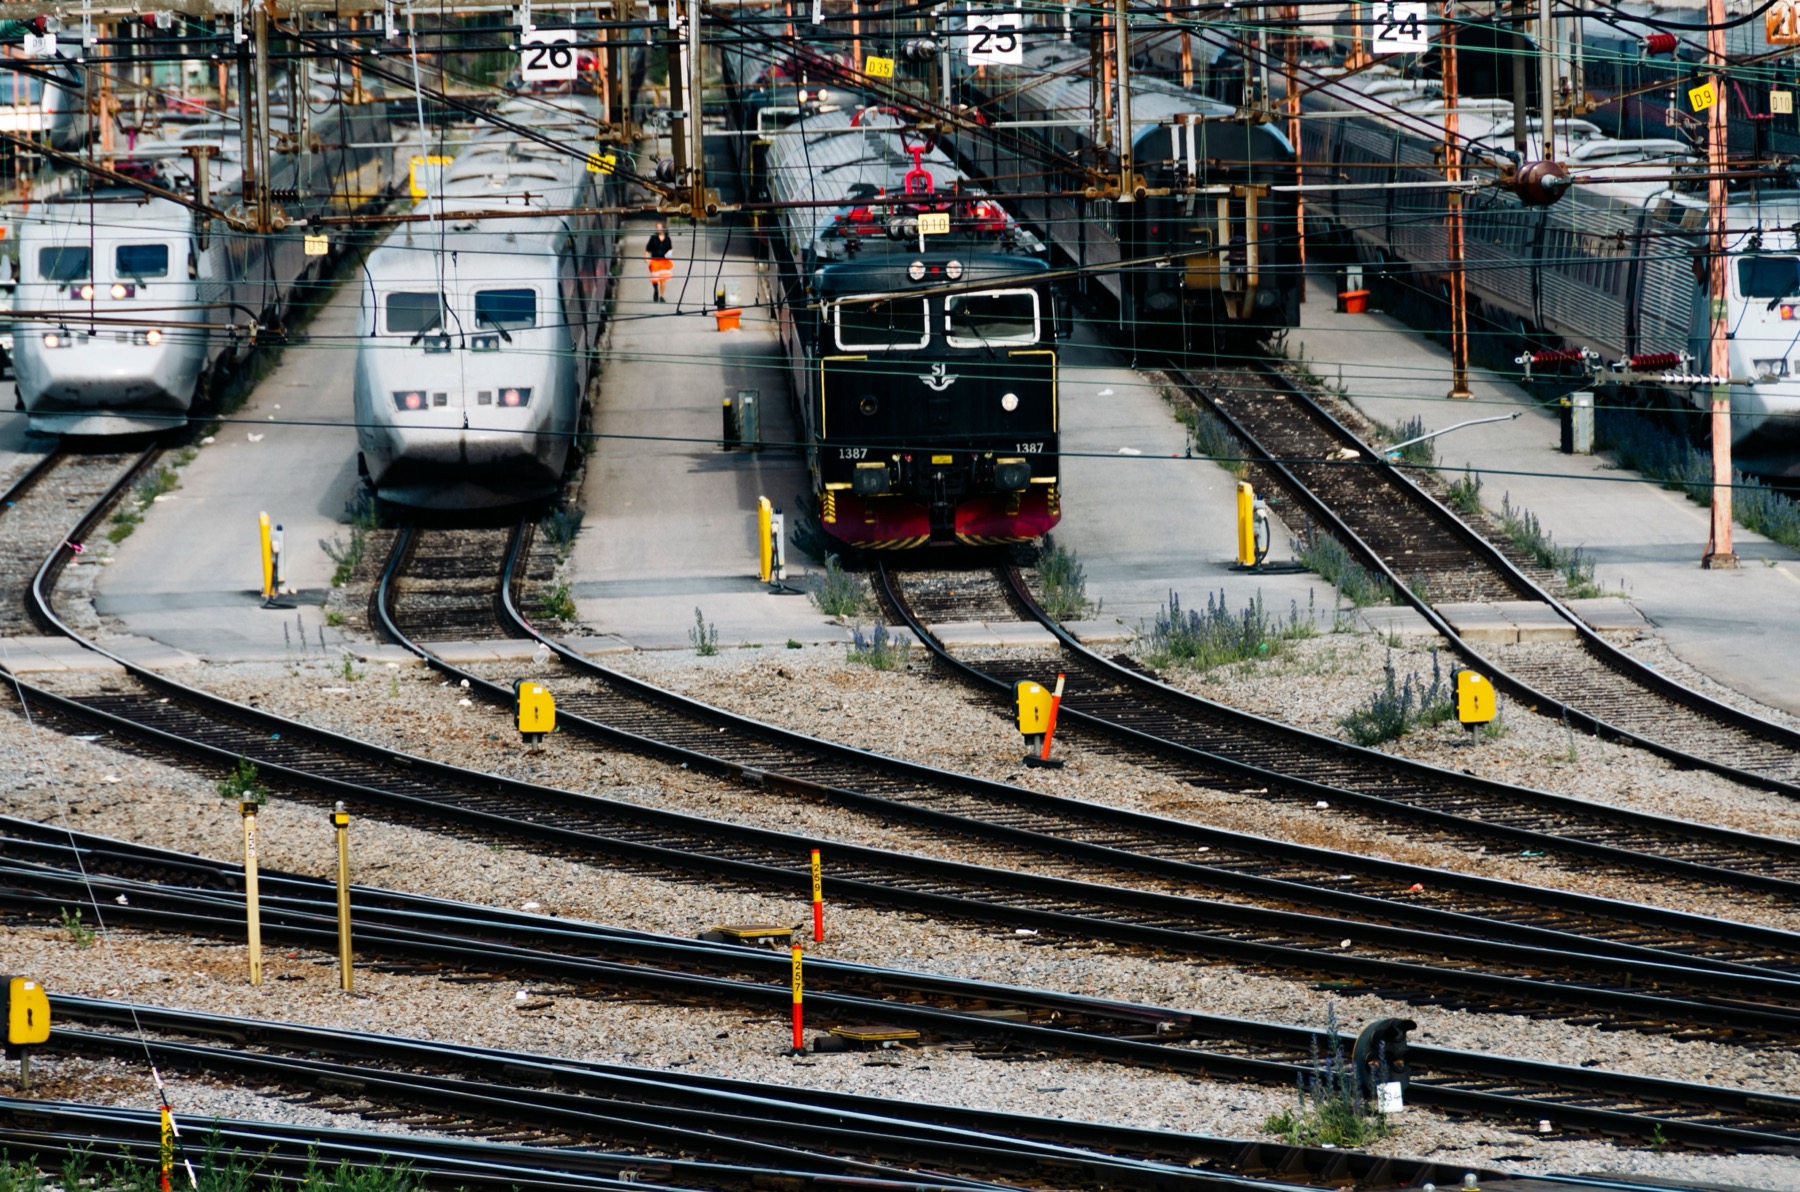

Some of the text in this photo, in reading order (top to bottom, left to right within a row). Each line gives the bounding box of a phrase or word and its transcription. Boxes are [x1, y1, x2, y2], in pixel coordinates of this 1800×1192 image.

[1377, 12, 1422, 42] 24
[972, 25, 1017, 53] 25
[527, 38, 573, 70] 26
[868, 61, 890, 75] D35
[1694, 90, 1712, 108] D9
[1772, 96, 1790, 111] D10
[921, 218, 946, 231] D10
[931, 362, 946, 376] SJ
[839, 448, 868, 459] 1387
[1016, 442, 1044, 454] 1387
[813, 863, 821, 892] 259
